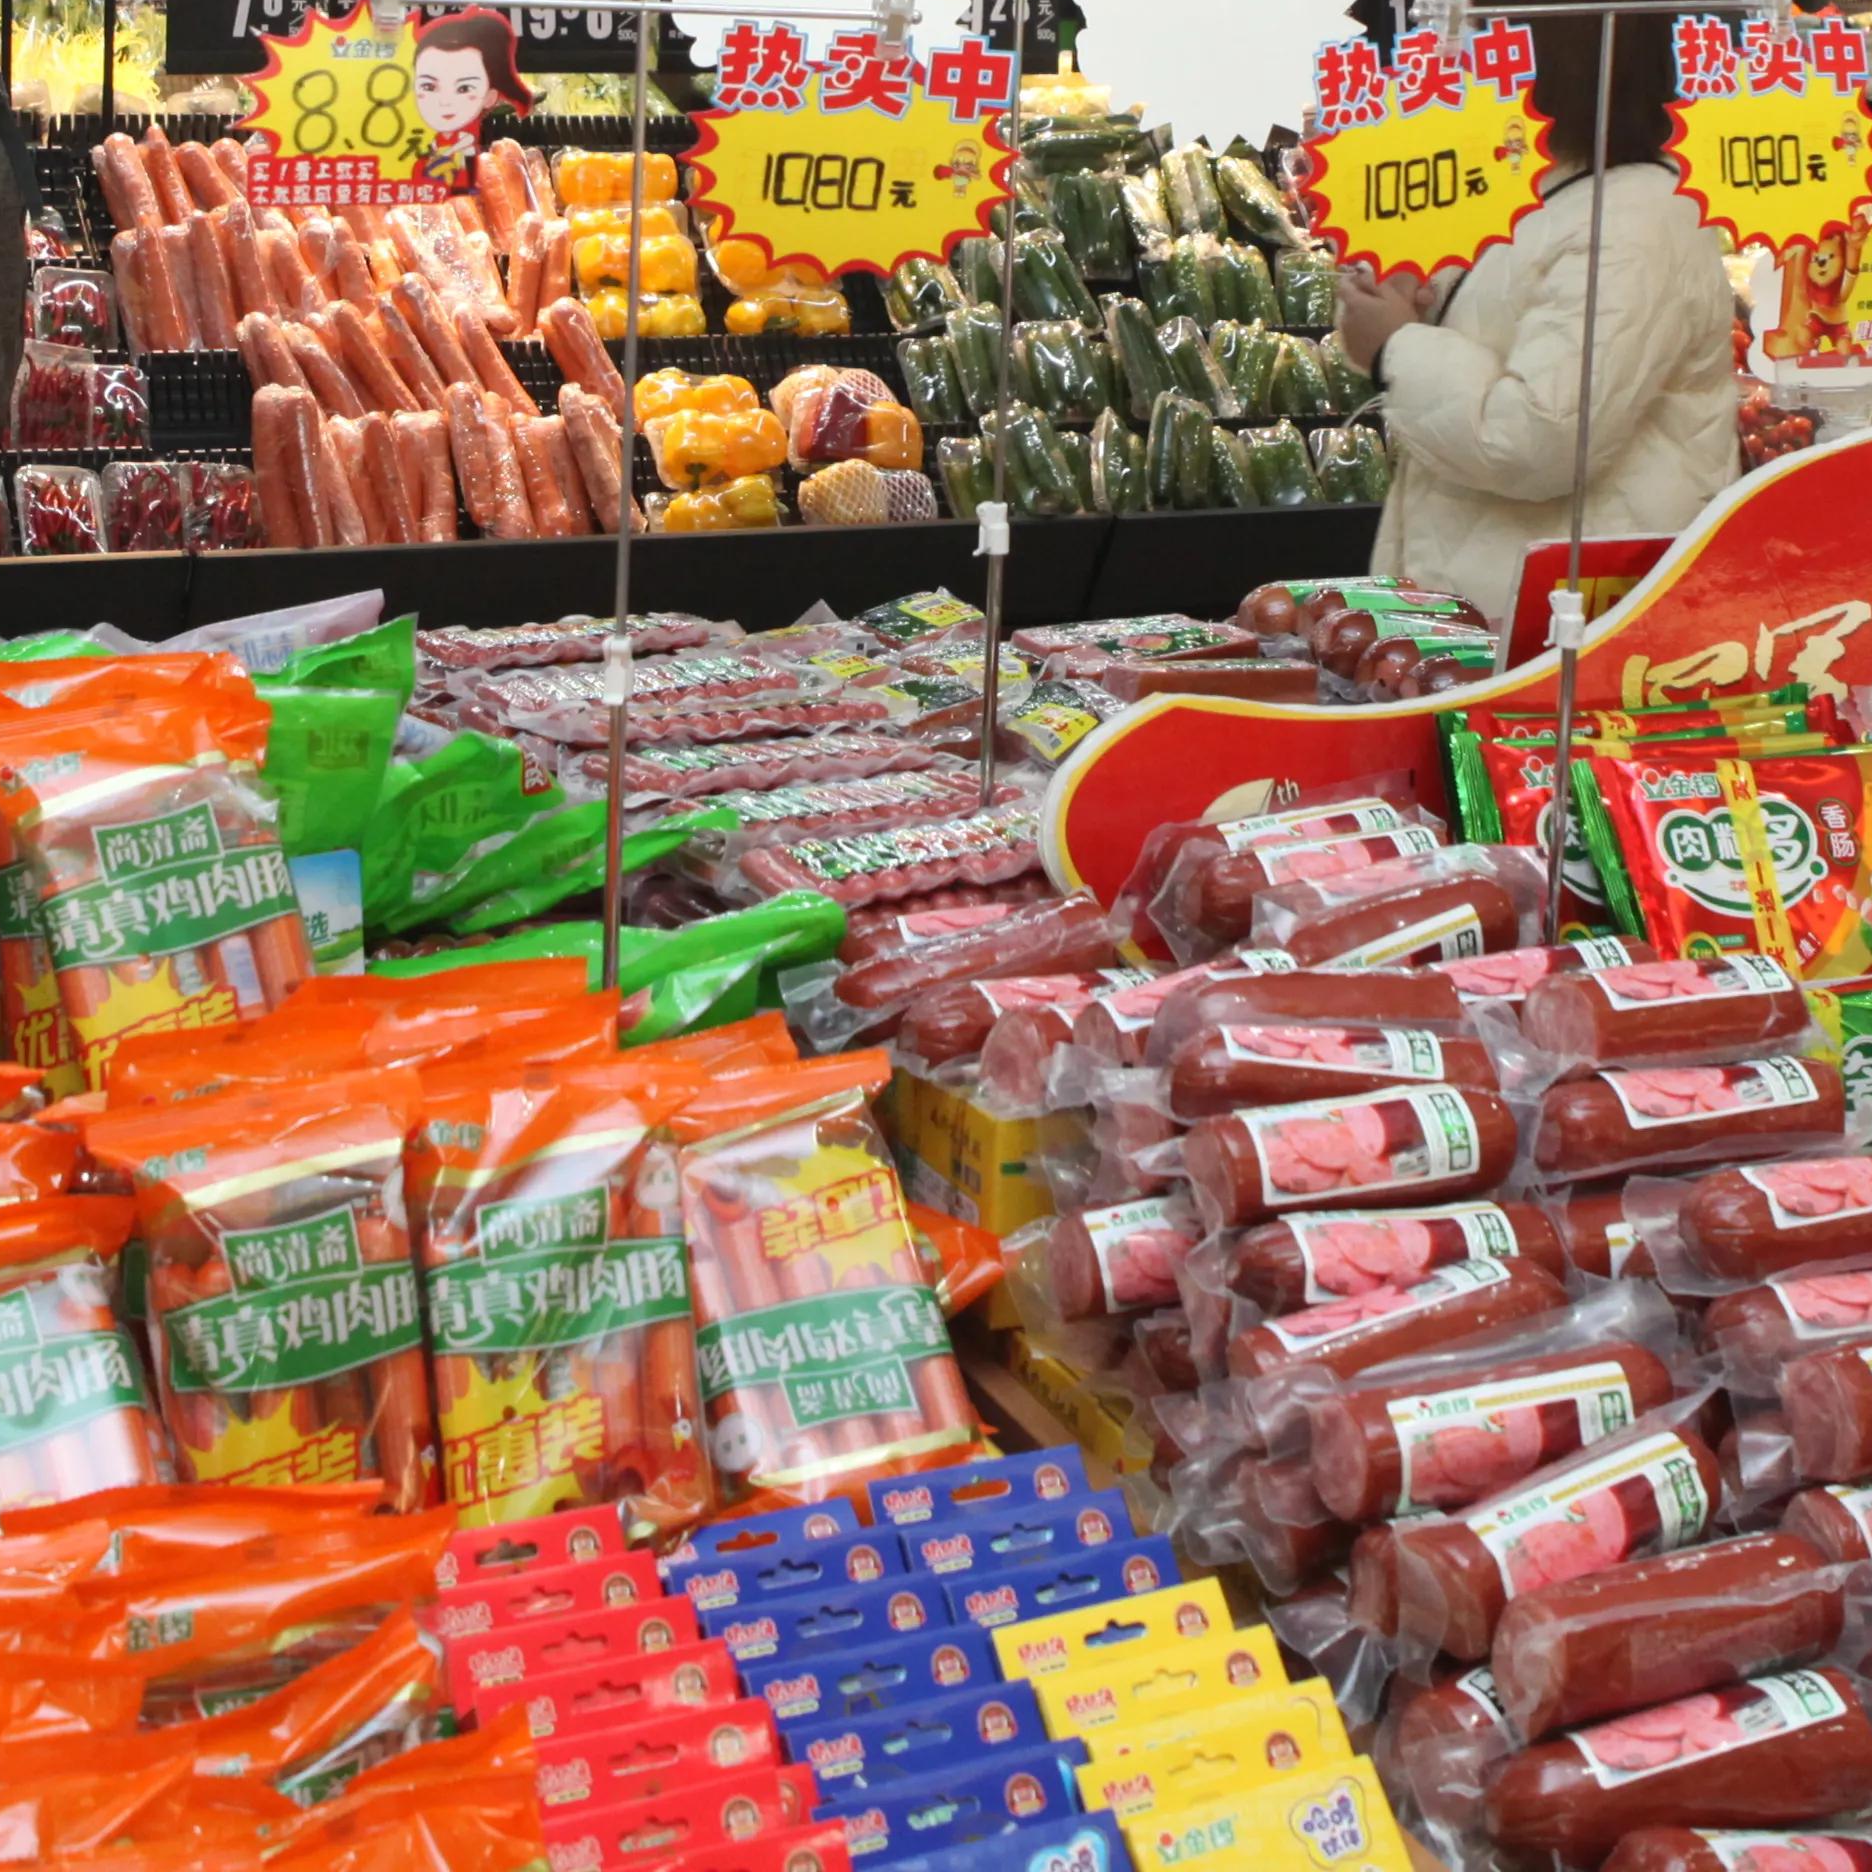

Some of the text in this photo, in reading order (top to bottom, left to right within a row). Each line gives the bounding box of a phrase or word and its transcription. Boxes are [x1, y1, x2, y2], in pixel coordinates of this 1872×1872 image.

[716, 21, 1016, 121] 热卖中
[1315, 18, 1536, 132] 热卖中
[1673, 16, 1870, 99] 热卖中
[102, 814, 214, 868] 尚清斋
[1819, 802, 1857, 860] 香肠
[51, 850, 294, 958] 清真鸡肉肠
[228, 1216, 355, 1287] 尚清斋
[483, 1190, 605, 1255] 尚清斋
[427, 1246, 687, 1346] 清真鸡肉肠
